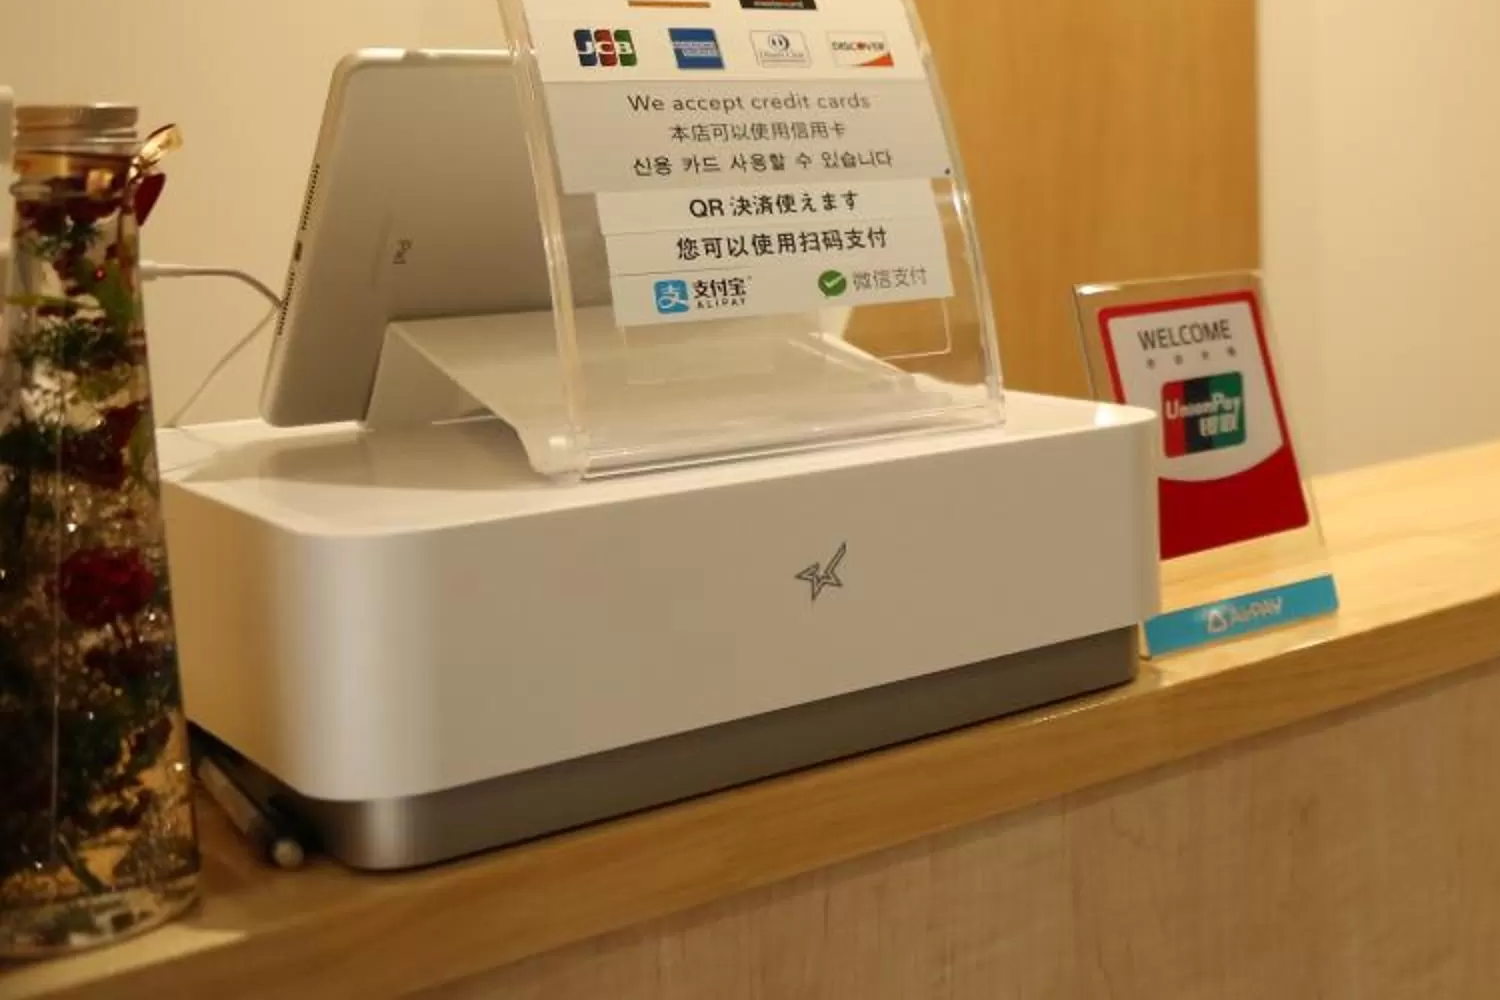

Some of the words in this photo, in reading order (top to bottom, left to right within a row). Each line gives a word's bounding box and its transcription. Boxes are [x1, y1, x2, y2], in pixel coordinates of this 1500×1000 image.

[627, 94, 664, 111] We
[672, 95, 745, 114] accept
[751, 91, 810, 110] credit
[817, 92, 872, 110] cards
[669, 121, 846, 143] 本店可以使用信用卡
[633, 155, 672, 177] 신용
[682, 154, 721, 174] 카드
[730, 152, 786, 173] 사용할
[795, 151, 813, 169] 수
[821, 148, 893, 169] 있습니다
[689, 199, 725, 218] QR
[730, 190, 859, 217] 決済使えます
[676, 225, 887, 261] 您可以使用扫码支付
[694, 277, 747, 299] 支付宝
[852, 266, 927, 290] 微信支付
[1137, 318, 1232, 351] WELCOME
